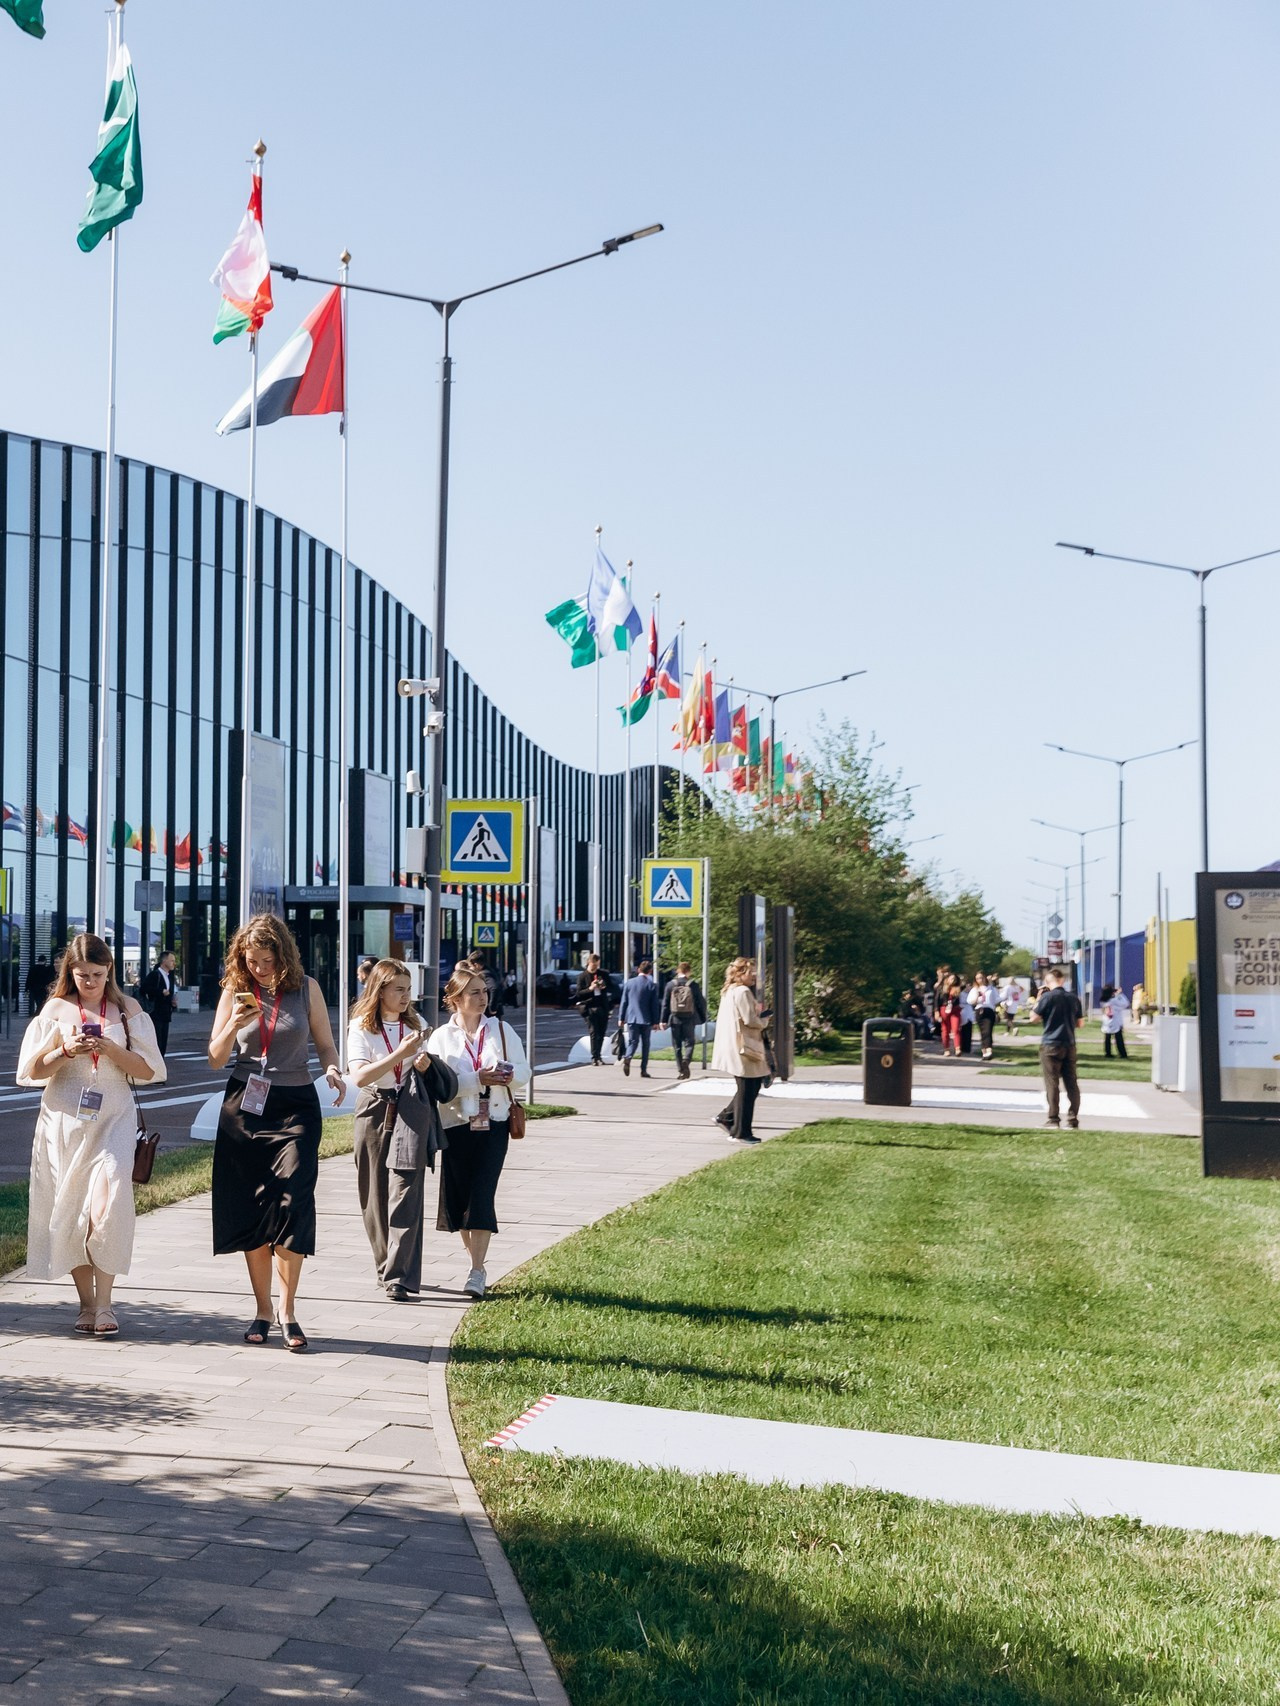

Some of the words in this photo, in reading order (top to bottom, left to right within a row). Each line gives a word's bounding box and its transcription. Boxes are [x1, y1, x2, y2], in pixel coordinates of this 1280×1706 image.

[1233, 937, 1255, 949] ST.
[1235, 962, 1280, 974] ECON
[1235, 974, 1280, 986] FORU
